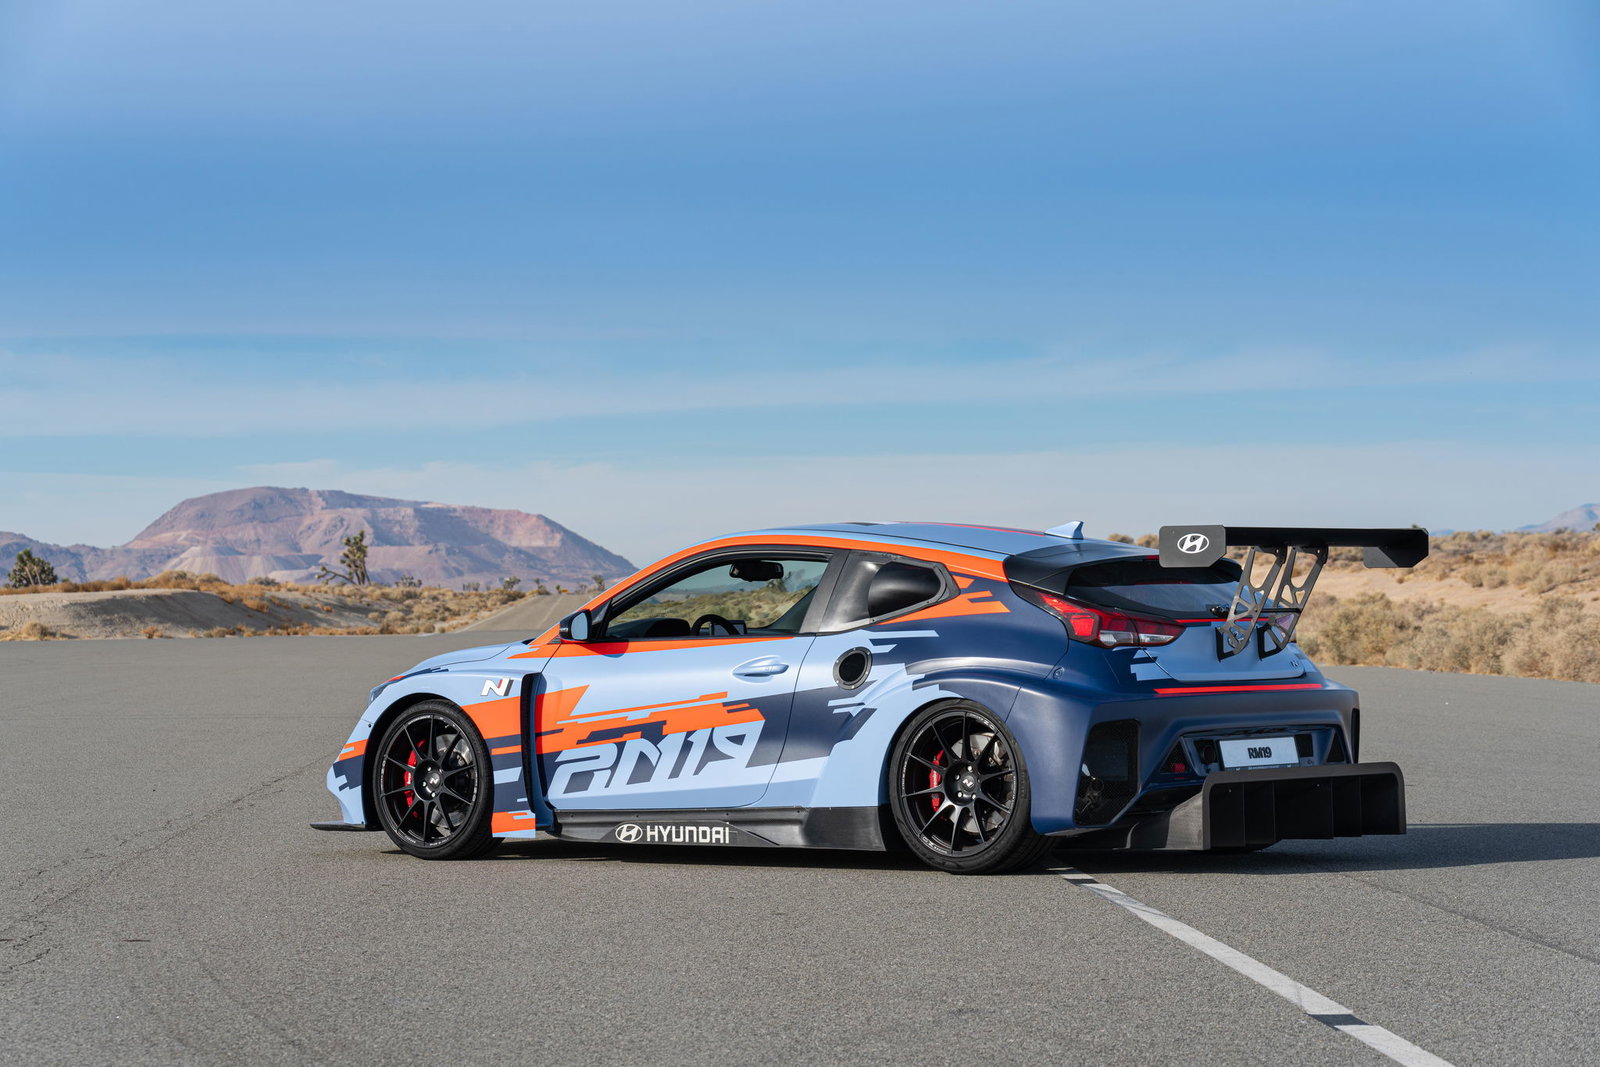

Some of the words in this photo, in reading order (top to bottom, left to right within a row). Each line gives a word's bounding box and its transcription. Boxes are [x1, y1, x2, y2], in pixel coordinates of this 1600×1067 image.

[480, 677, 513, 696] N
[549, 719, 766, 795] RM19
[1248, 746, 1272, 759] RM19
[646, 825, 730, 844] HYUNDAI
